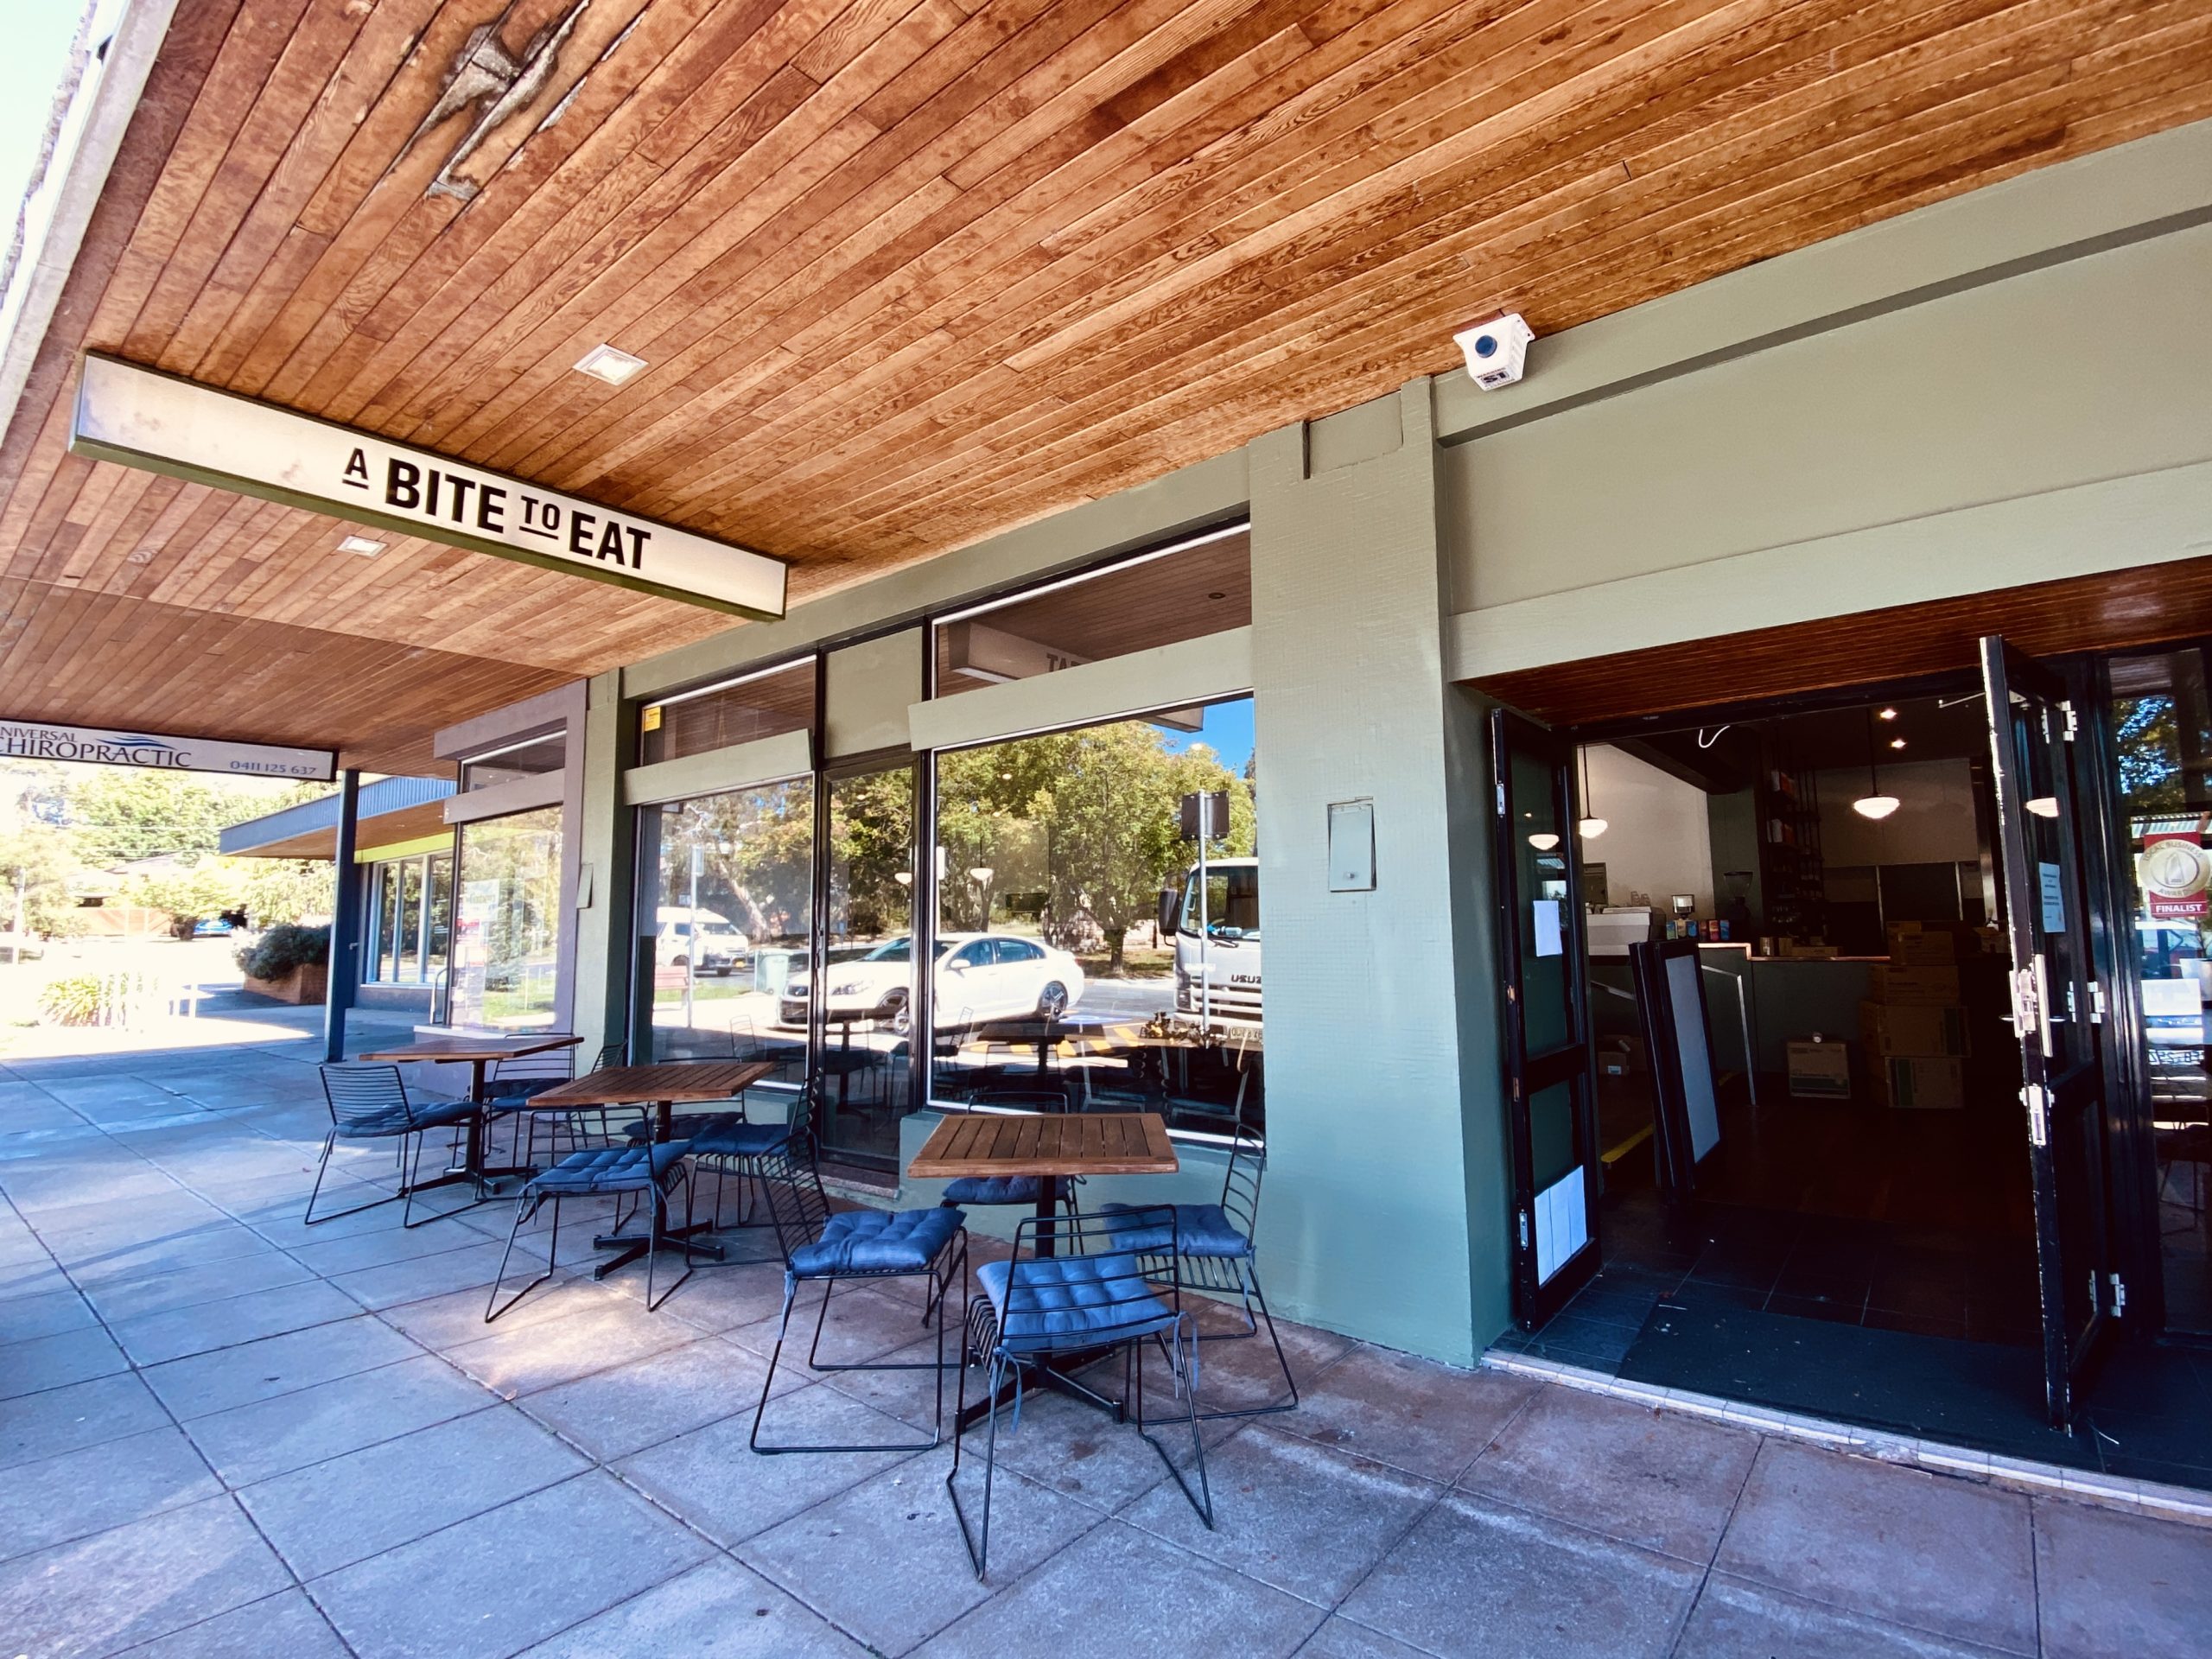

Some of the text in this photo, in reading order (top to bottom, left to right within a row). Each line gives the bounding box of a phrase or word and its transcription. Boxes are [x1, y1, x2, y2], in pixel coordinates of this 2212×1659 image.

[344, 448, 652, 570] A BITE TO EAT
[0, 727, 78, 743] NIVERSAL
[0, 736, 192, 767] HIROPRACTIC
[230, 760, 316, 775] 0411 125 637
[2165, 841, 2203, 858] BUSINESS
[2155, 904, 2202, 913] FINALIST
